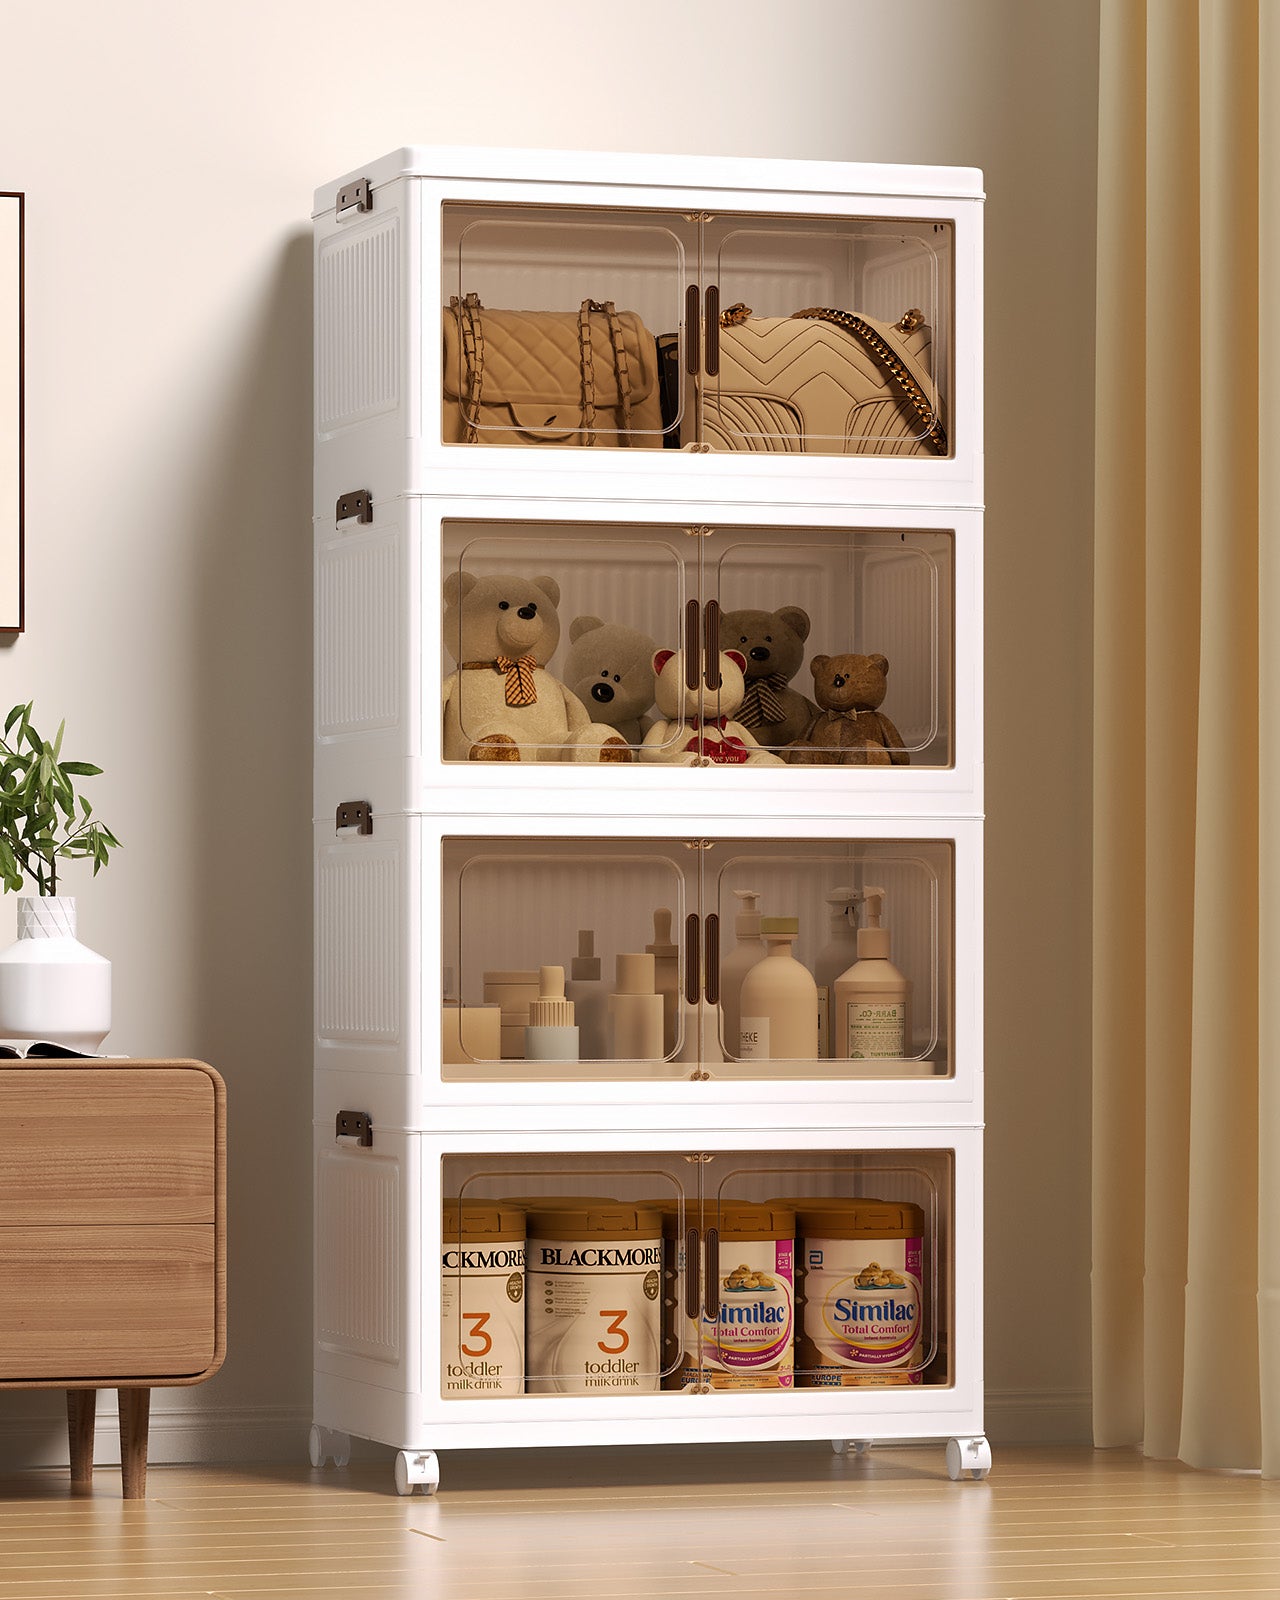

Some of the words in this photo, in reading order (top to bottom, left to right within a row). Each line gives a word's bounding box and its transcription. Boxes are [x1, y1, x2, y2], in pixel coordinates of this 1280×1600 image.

[725, 756, 739, 764] you
[833, 1298, 914, 1322] Similac
[461, 1312, 492, 1357] 3
[597, 1310, 630, 1354] 3
[711, 1326, 739, 1338] Total
[740, 1326, 780, 1337] Comfort
[842, 1324, 869, 1335] Total
[870, 1323, 911, 1335] Comfort
[446, 1361, 503, 1377] toddler
[584, 1358, 640, 1374] toddler
[447, 1378, 474, 1390] milk
[474, 1378, 503, 1390] drink
[585, 1376, 611, 1387] milk
[611, 1376, 640, 1387] drink
